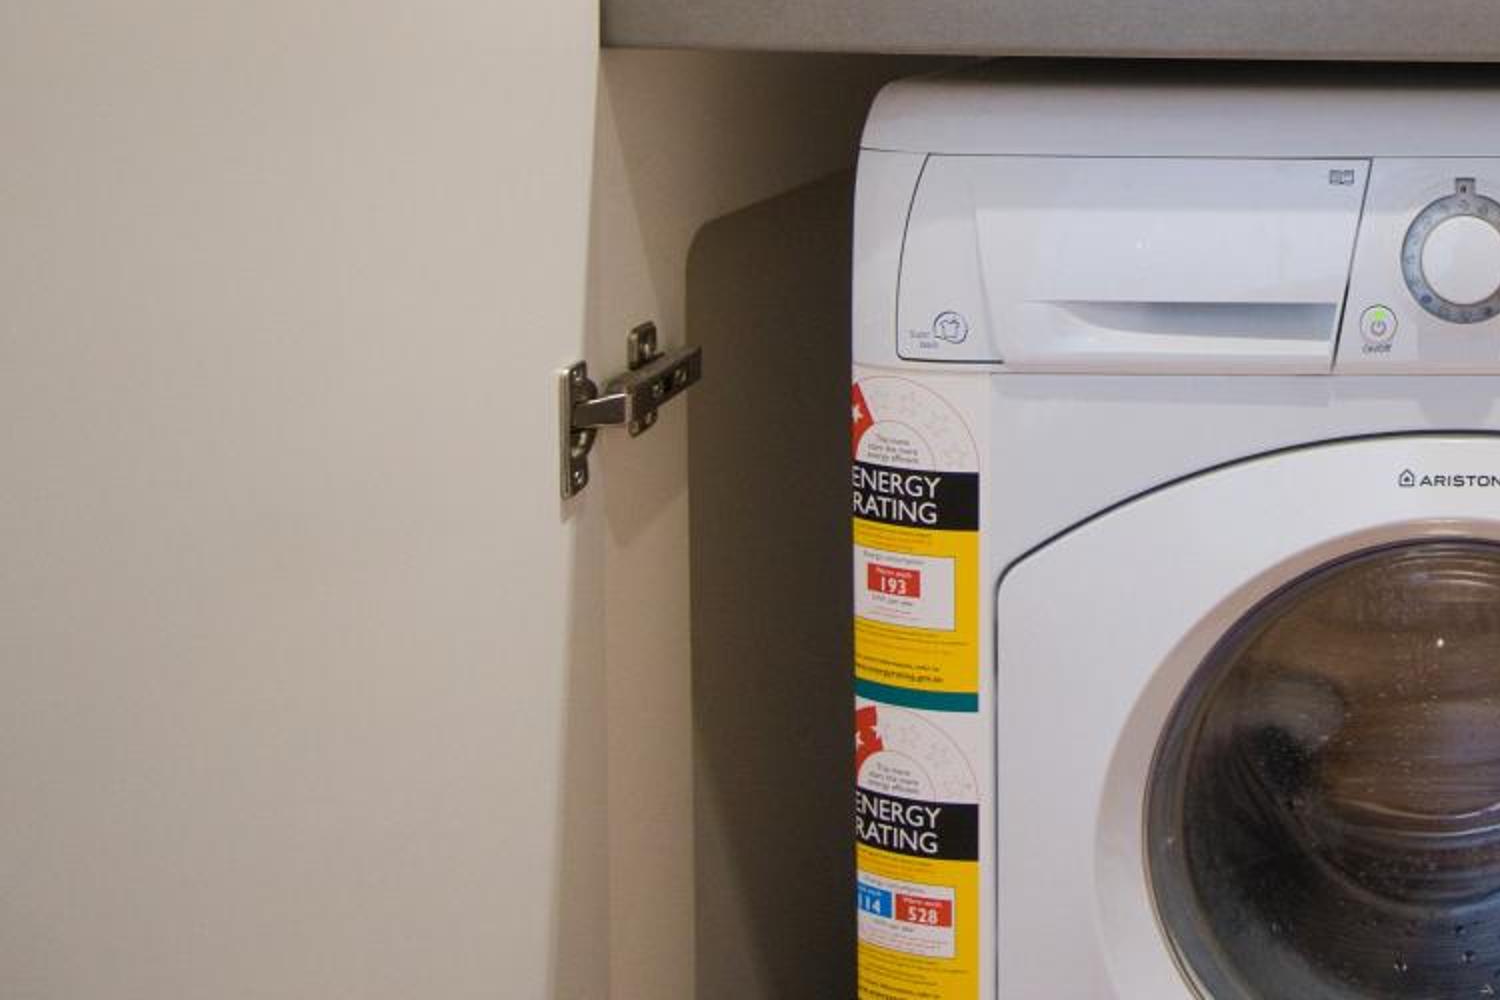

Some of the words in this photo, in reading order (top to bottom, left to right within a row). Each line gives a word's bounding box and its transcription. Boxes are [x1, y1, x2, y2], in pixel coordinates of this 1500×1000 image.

[852, 464, 942, 499] ENERGY
[853, 491, 938, 525] RATING
[880, 575, 907, 595] 193
[856, 815, 938, 854] RATING
[907, 905, 938, 925] 528
